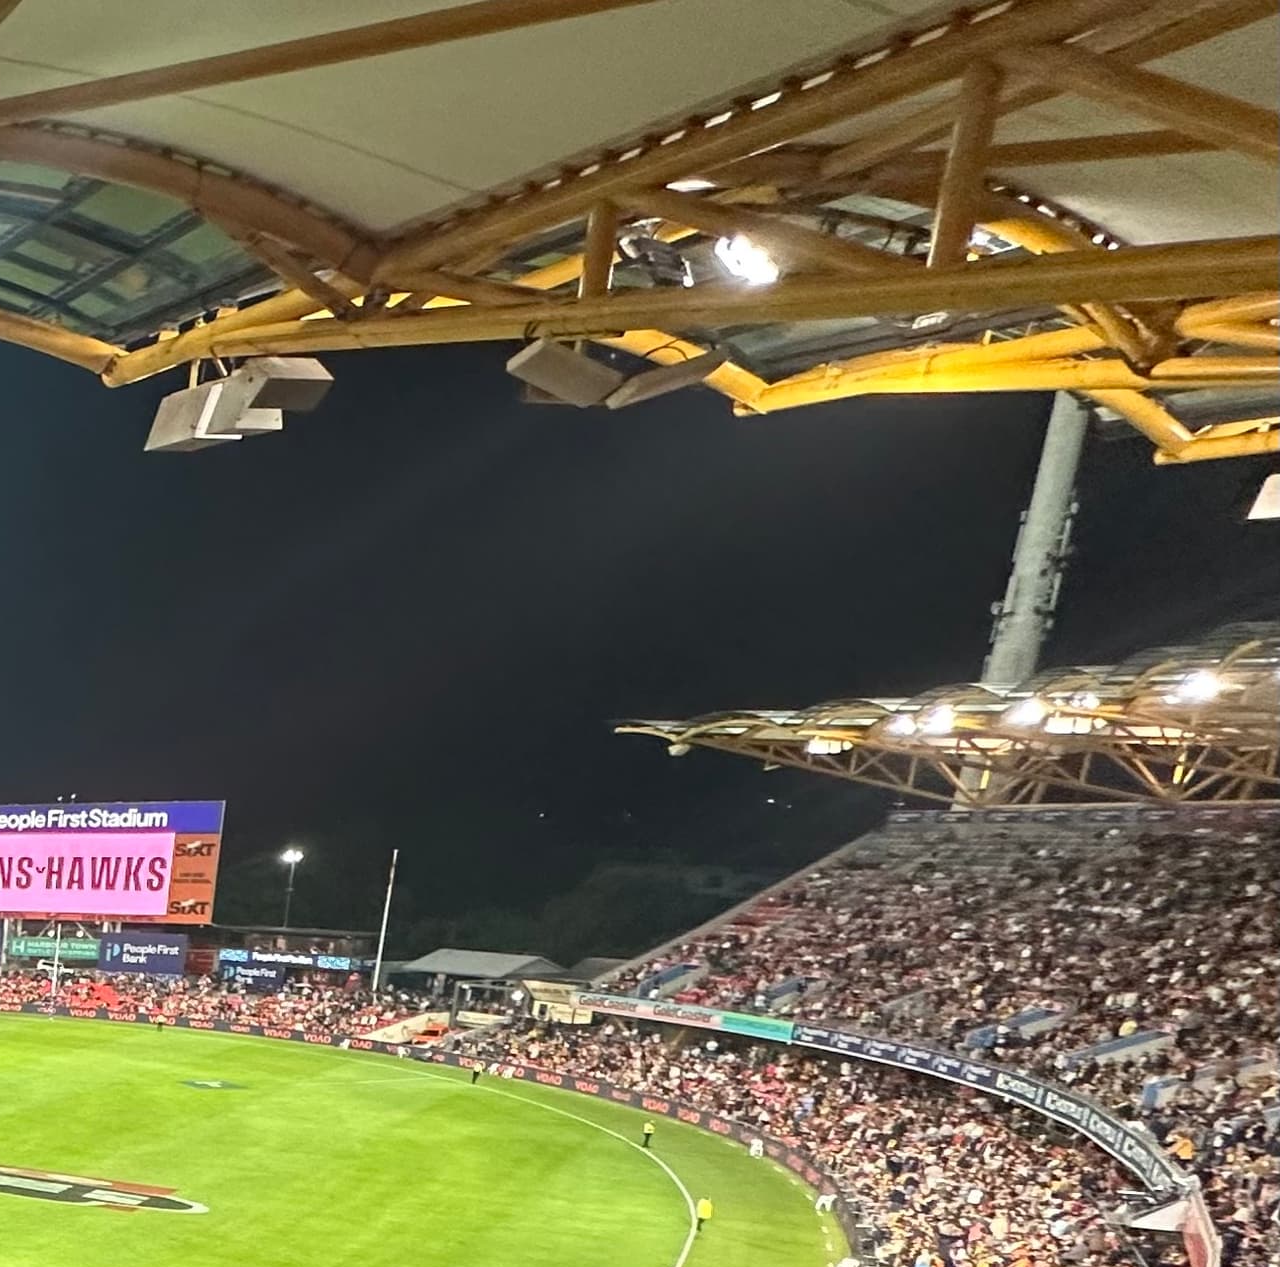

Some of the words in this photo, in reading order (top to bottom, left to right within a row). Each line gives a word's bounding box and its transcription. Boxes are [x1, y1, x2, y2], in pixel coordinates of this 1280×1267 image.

[47, 810, 88, 828] First
[89, 808, 168, 828] Stadium
[46, 857, 167, 891] HAWKS
[122, 943, 155, 956] People
[157, 945, 180, 956] First
[122, 953, 147, 964] Bank
